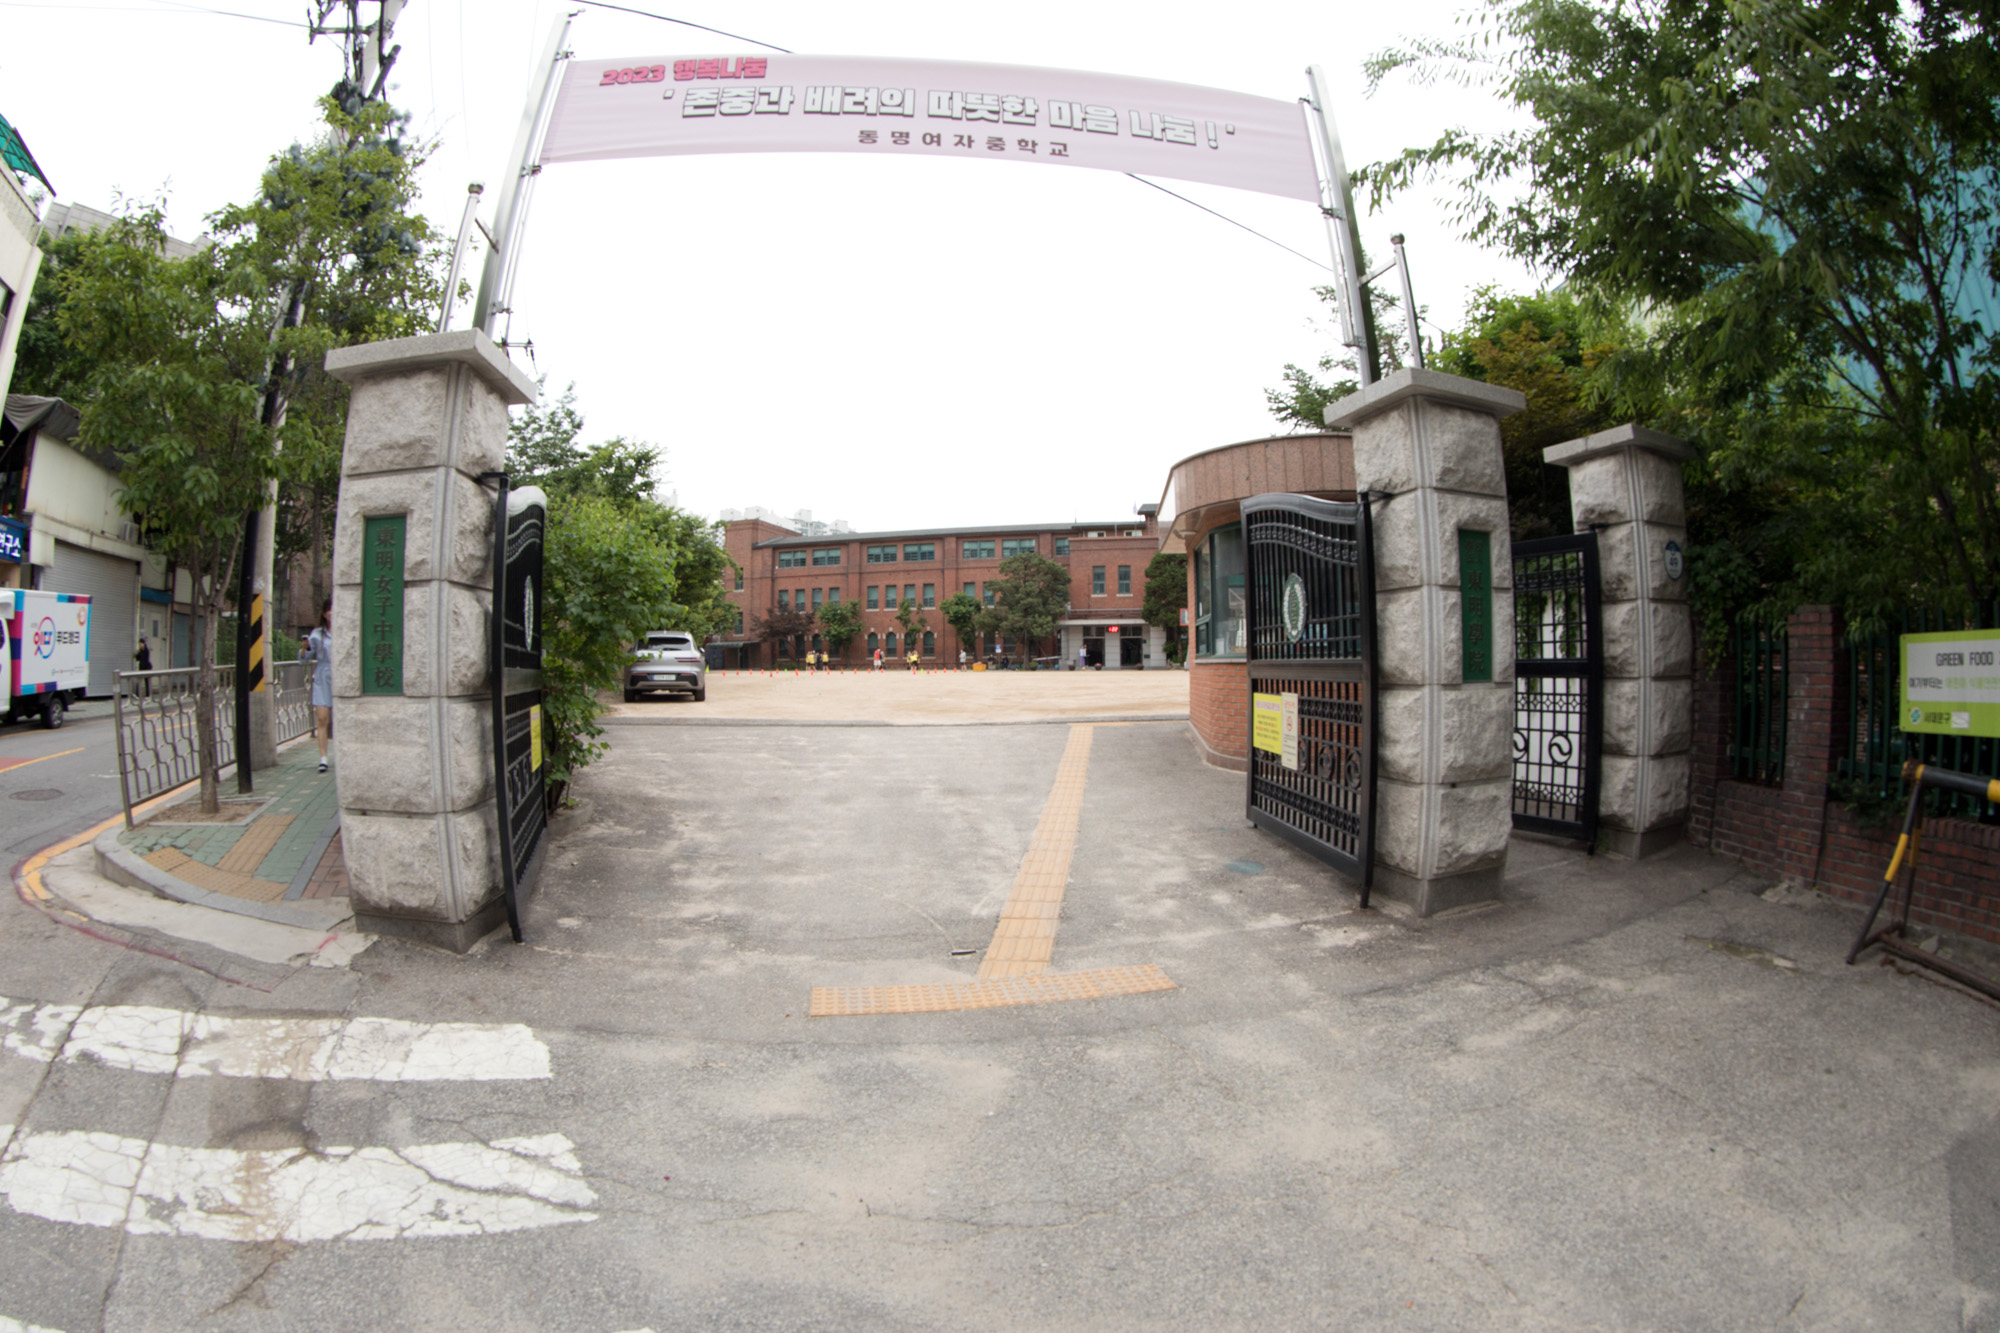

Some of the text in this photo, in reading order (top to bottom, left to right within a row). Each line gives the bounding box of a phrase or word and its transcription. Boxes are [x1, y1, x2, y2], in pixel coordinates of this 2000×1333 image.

[600, 58, 768, 85] 2023 행복나눔
[803, 86, 915, 117] 배려의
[928, 89, 1039, 125] 따뜻한
[1048, 100, 1119, 135] 마음
[373, 526, 396, 689] 東明女子中學校
[1936, 652, 1964, 667] GREEN
[1969, 651, 1994, 666] FOOD
